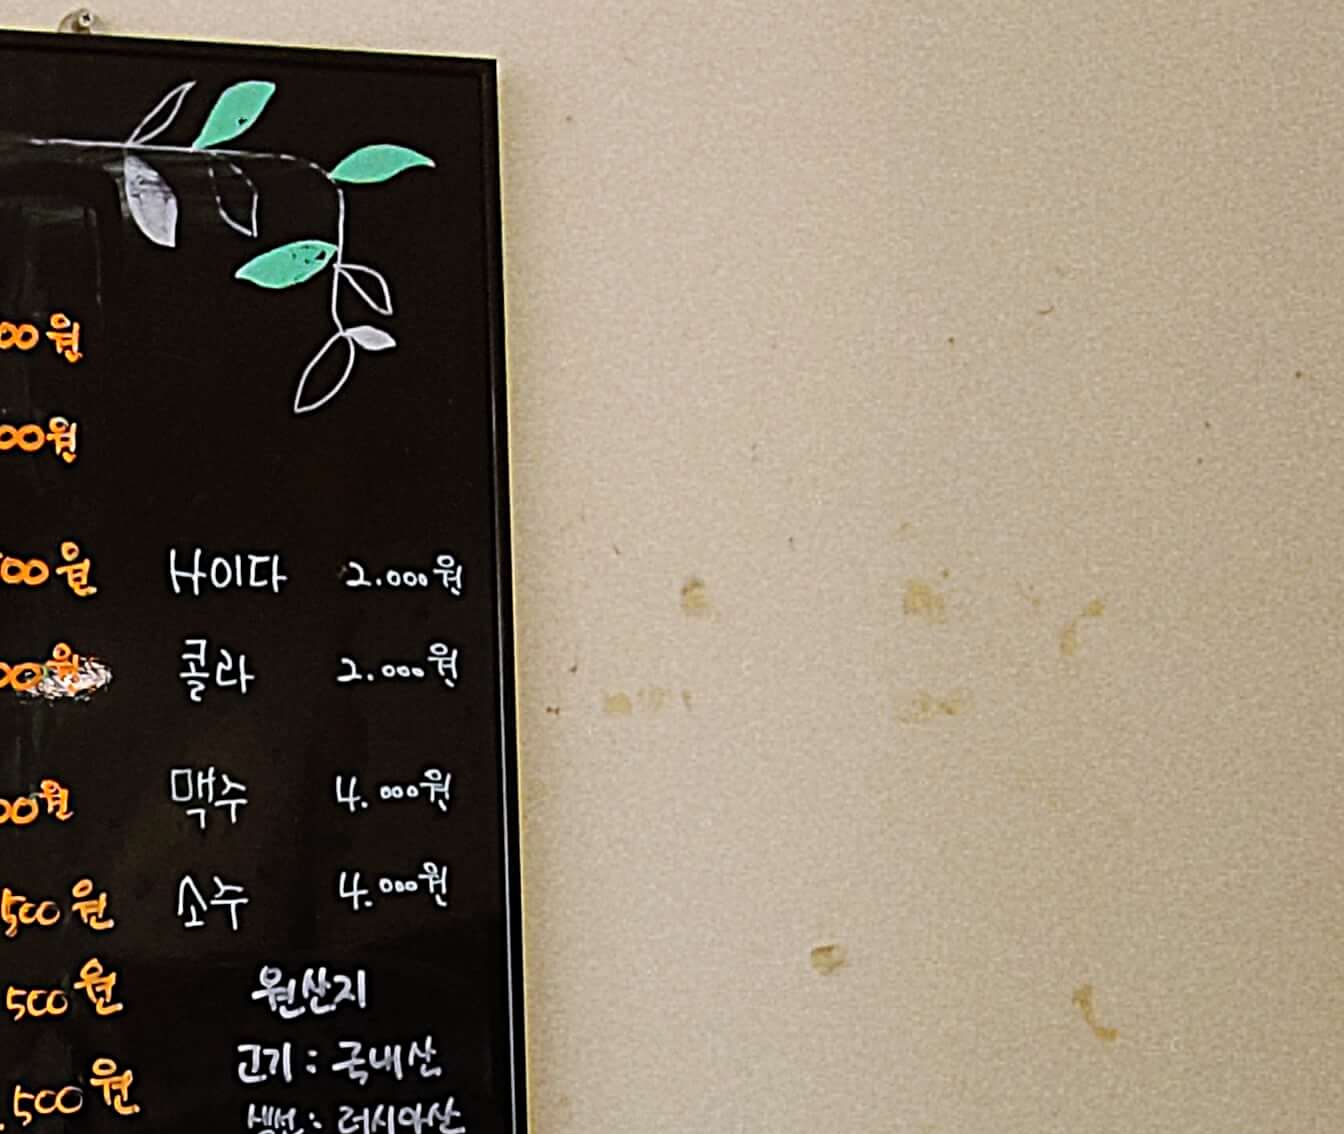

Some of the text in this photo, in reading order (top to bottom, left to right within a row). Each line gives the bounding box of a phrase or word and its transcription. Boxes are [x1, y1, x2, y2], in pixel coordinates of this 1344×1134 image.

[178, 638, 256, 703] 콜라
[170, 765, 249, 830] 맥주
[250, 964, 367, 1020] 원산지
[330, 1034, 443, 1086] 국내산
